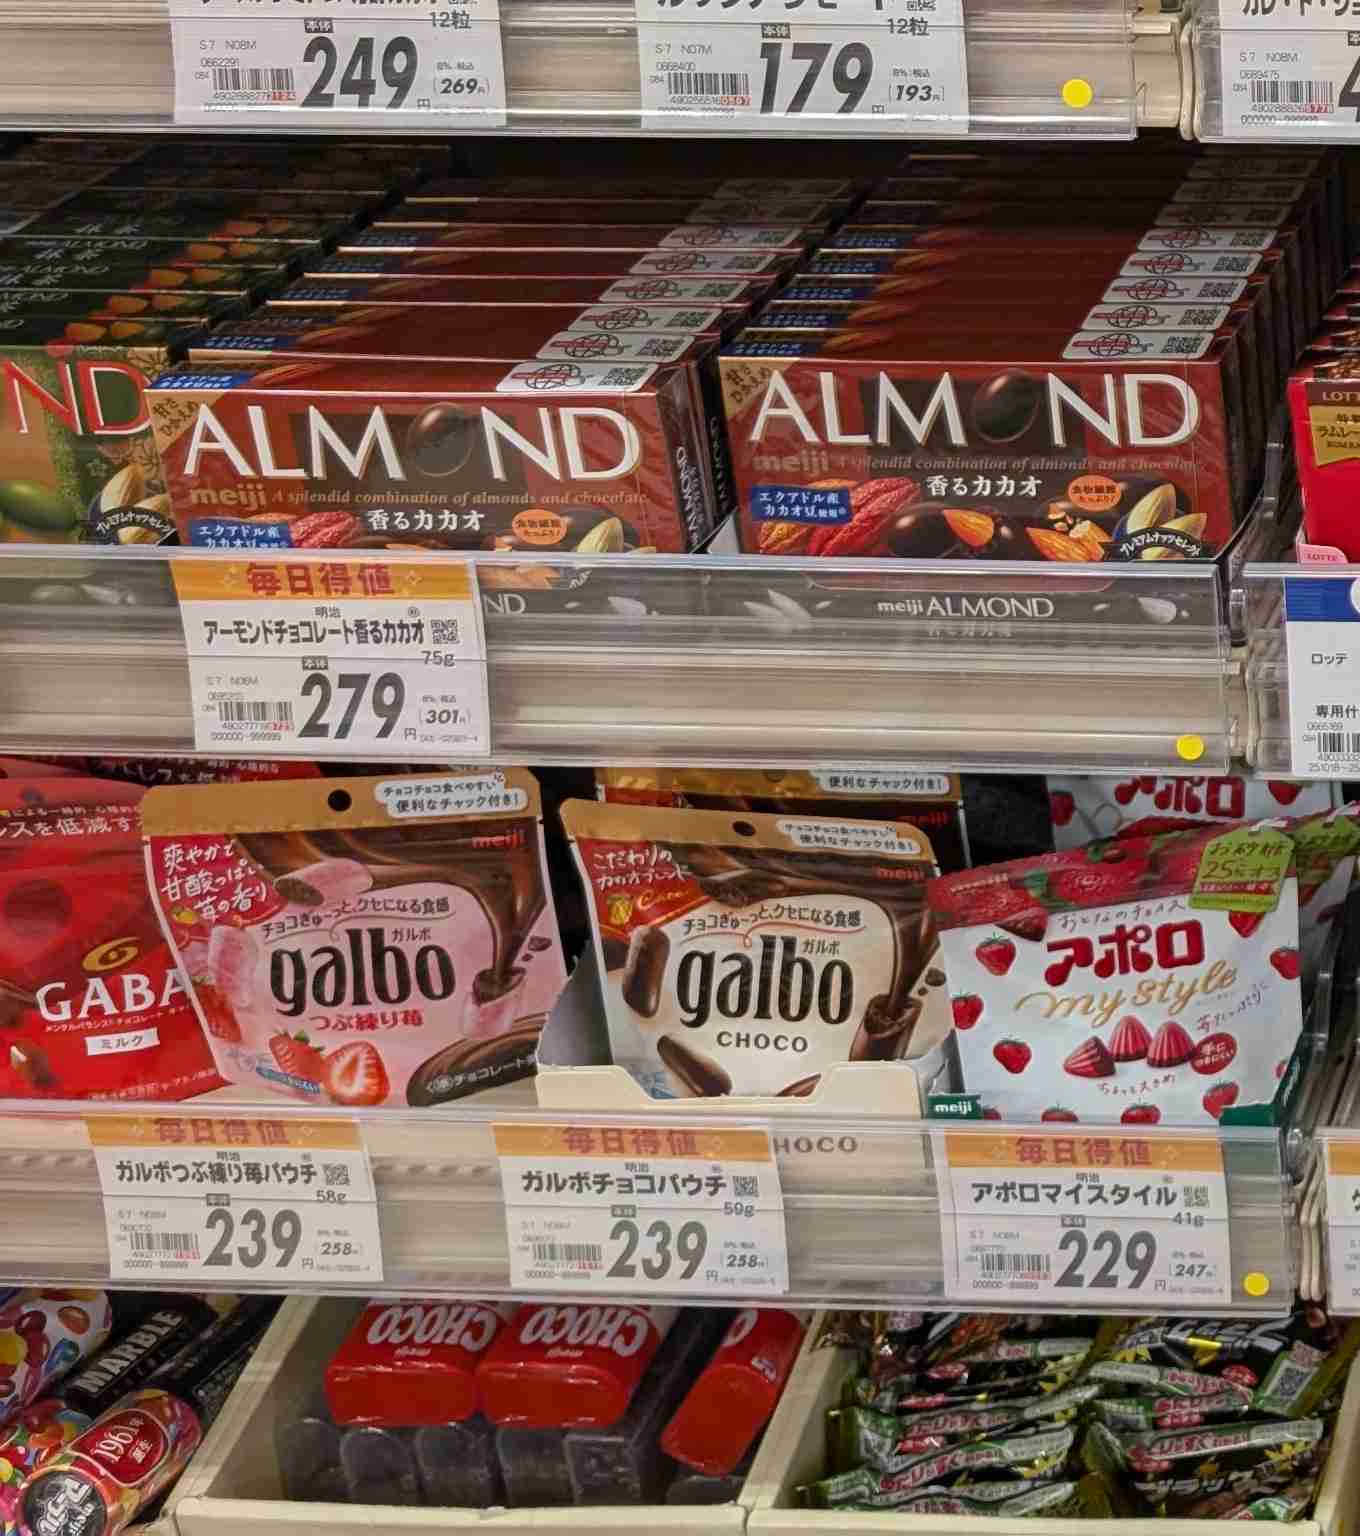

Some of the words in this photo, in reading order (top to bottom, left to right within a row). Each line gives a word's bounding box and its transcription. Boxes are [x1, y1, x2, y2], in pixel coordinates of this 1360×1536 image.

[887, 16, 929, 38] 12粒
[297, 35, 419, 112] 249
[757, 41, 874, 116] 179
[926, 475, 1044, 498] 香るカカオ
[367, 509, 485, 532] 香るカカオ
[204, 618, 425, 646] アーモンドチョコレート香るカカオ
[421, 650, 455, 667] 75g
[1310, 653, 1348, 666] ロッテ
[298, 672, 406, 739] 279
[270, 927, 456, 1019] galbo
[36, 969, 195, 1022] GABA
[308, 1013, 425, 1033] つぶ練り苺
[99, 1034, 145, 1051] ミルク
[717, 1030, 808, 1053] CHOCO
[934, 1102, 973, 1114] meiji
[116, 1159, 318, 1187] ガルボつぶ練り苺パウチ
[521, 1170, 727, 1200] ガルボチョコパウチ
[971, 1181, 1178, 1210] アポロマイスタイル
[204, 1207, 303, 1270] 239
[604, 1218, 708, 1281] 239
[1054, 1228, 1158, 1290] 229
[74, 1309, 186, 1393] MARBLE
